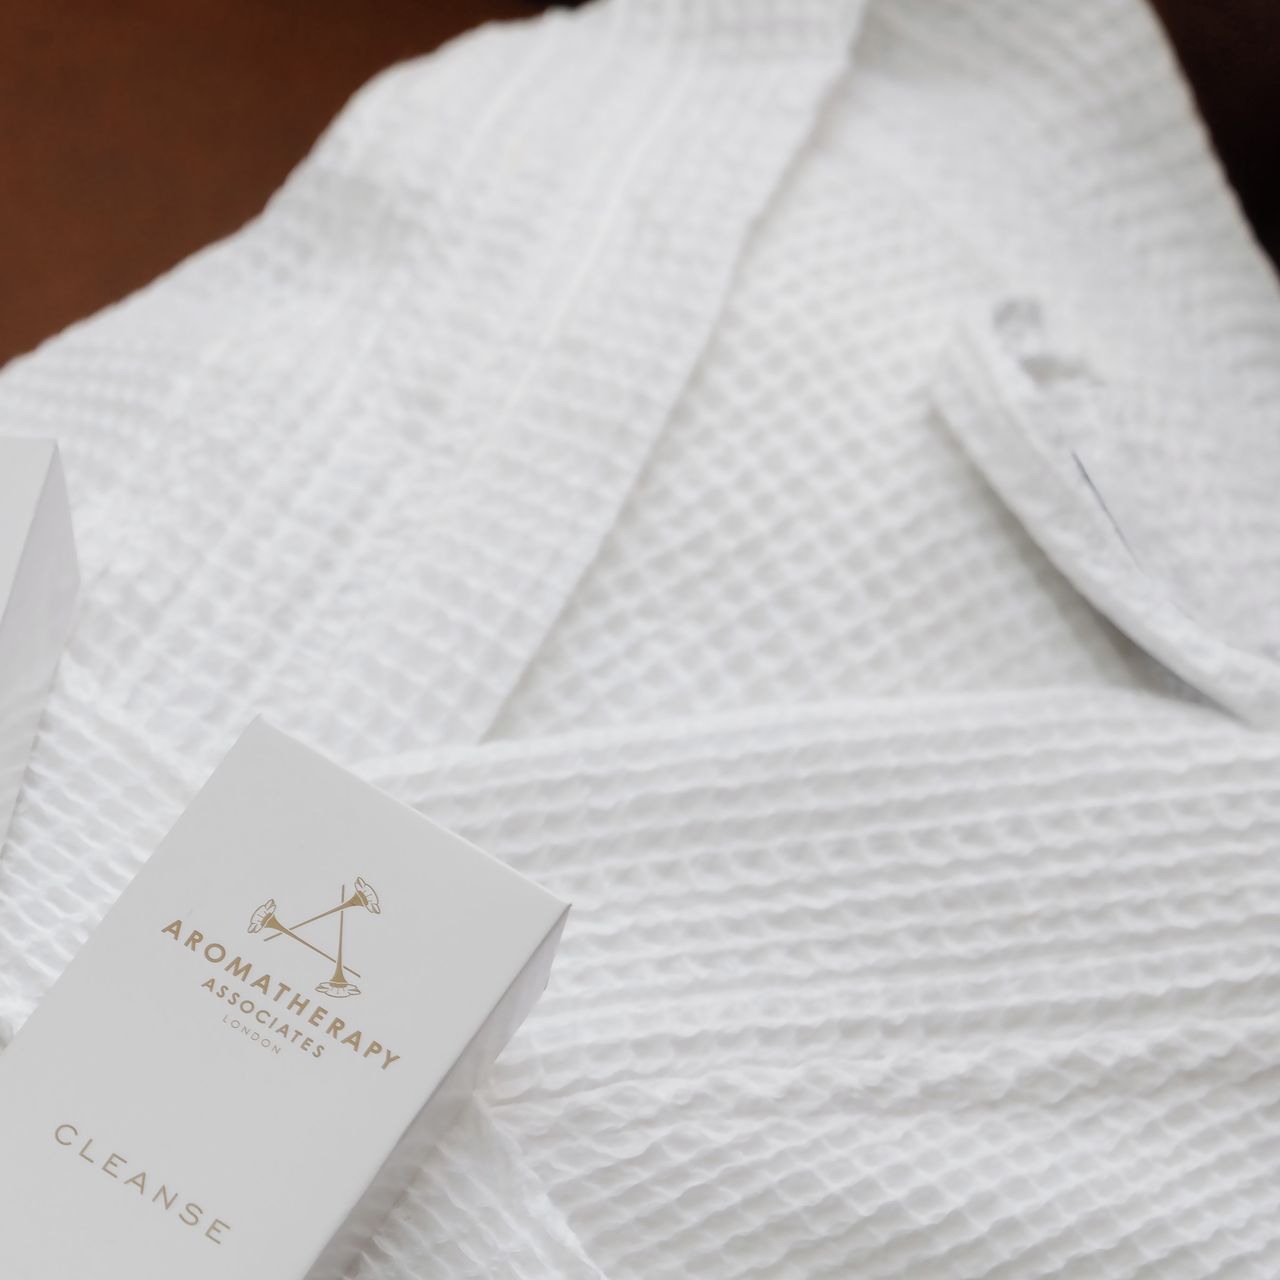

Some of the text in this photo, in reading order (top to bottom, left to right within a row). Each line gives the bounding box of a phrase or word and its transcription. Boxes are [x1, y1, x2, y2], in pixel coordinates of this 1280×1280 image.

[161, 919, 400, 1071] AROMATHERAPY
[201, 976, 325, 1059] ASSOCIATES
[222, 1014, 282, 1055] LONDON
[54, 1123, 231, 1245] CLEANSE
